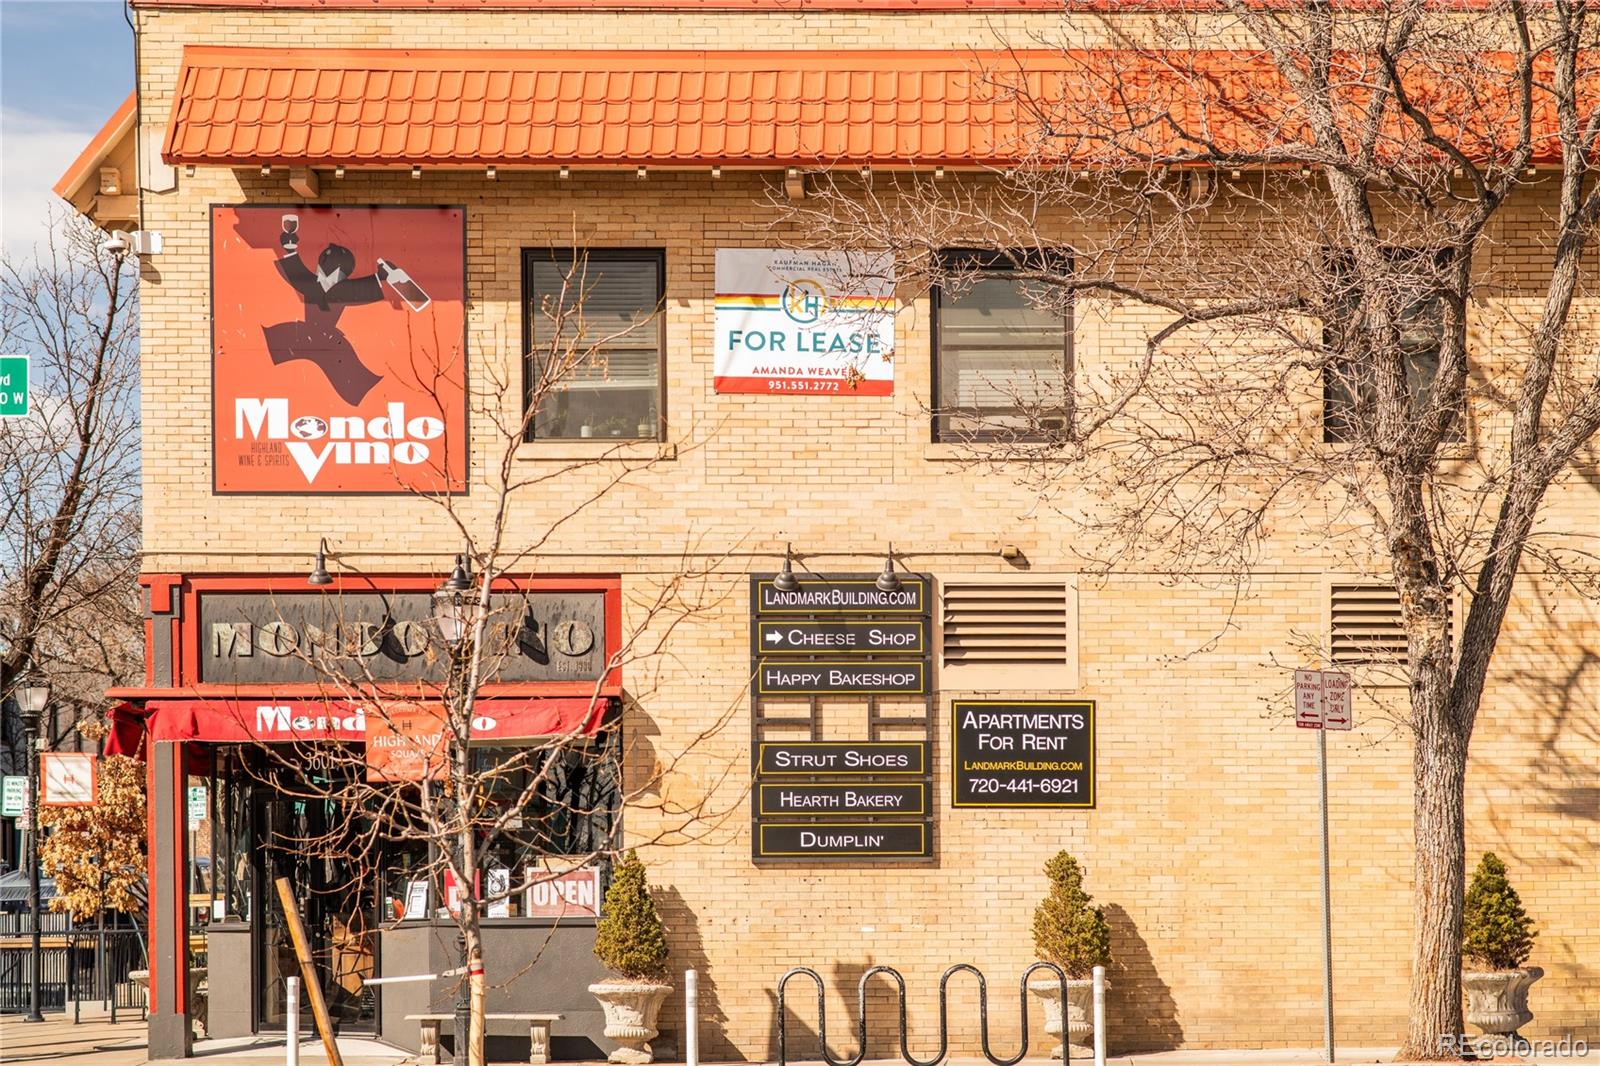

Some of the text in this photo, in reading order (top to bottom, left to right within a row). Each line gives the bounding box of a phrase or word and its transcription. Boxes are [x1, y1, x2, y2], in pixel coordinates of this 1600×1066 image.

[728, 330, 881, 354] FOR LEASE
[752, 366, 851, 376] AMANDA WEAVE
[768, 381, 839, 391] 951.551.2772
[13, 392, 24, 405] W
[235, 398, 445, 440] Mondo
[251, 442, 282, 453] HIGHLAND
[238, 455, 255, 466] WINE
[264, 455, 290, 466] SPIRITS
[284, 441, 430, 484] Vino
[1297, 682, 1321, 691] PARKING
[256, 706, 367, 732] Mond
[373, 734, 443, 748] HIGHAND
[969, 778, 1078, 793] 720-441-6921
[533, 880, 593, 906] OPEN
